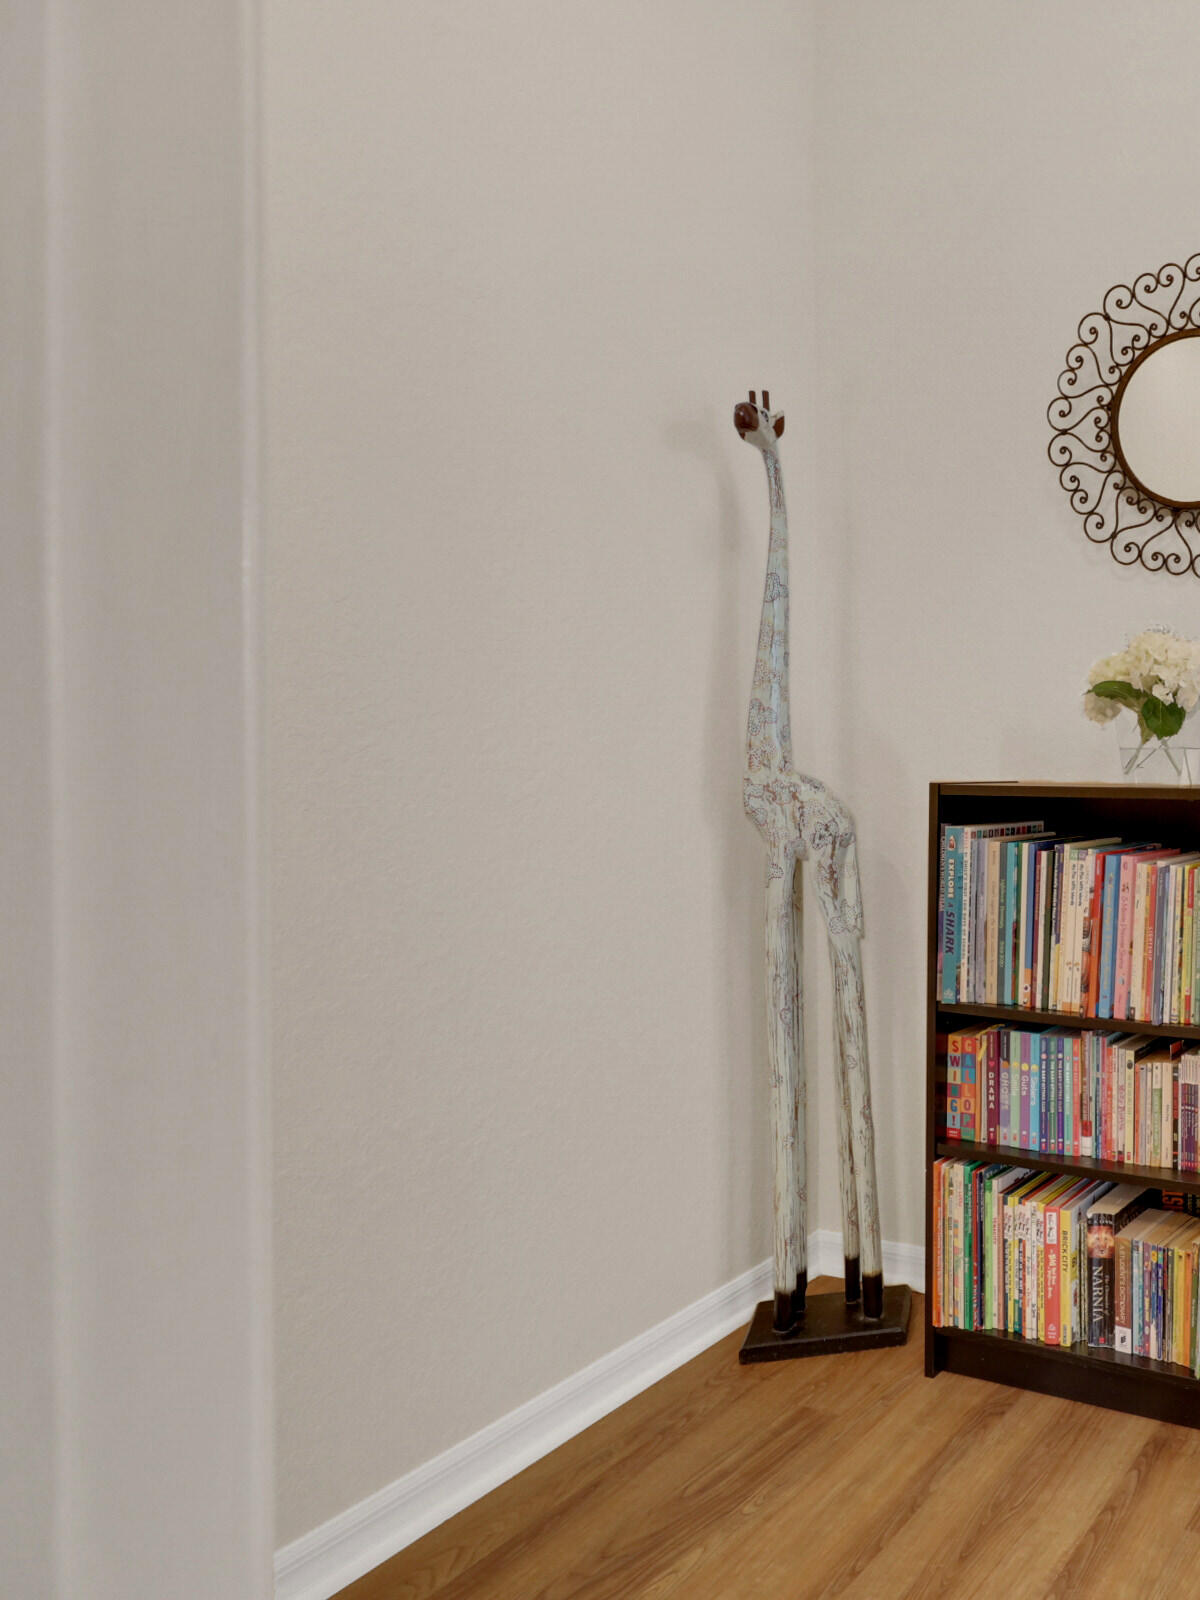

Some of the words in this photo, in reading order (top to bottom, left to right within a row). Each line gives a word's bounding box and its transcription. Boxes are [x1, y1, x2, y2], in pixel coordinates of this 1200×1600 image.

[948, 858, 956, 899] EXPLORE
[945, 911, 956, 955] SHARK
[988, 1072, 996, 1110] DRAMA
[1020, 1075, 1030, 1097] Guts
[1092, 1265, 1104, 1322] NARNIA
